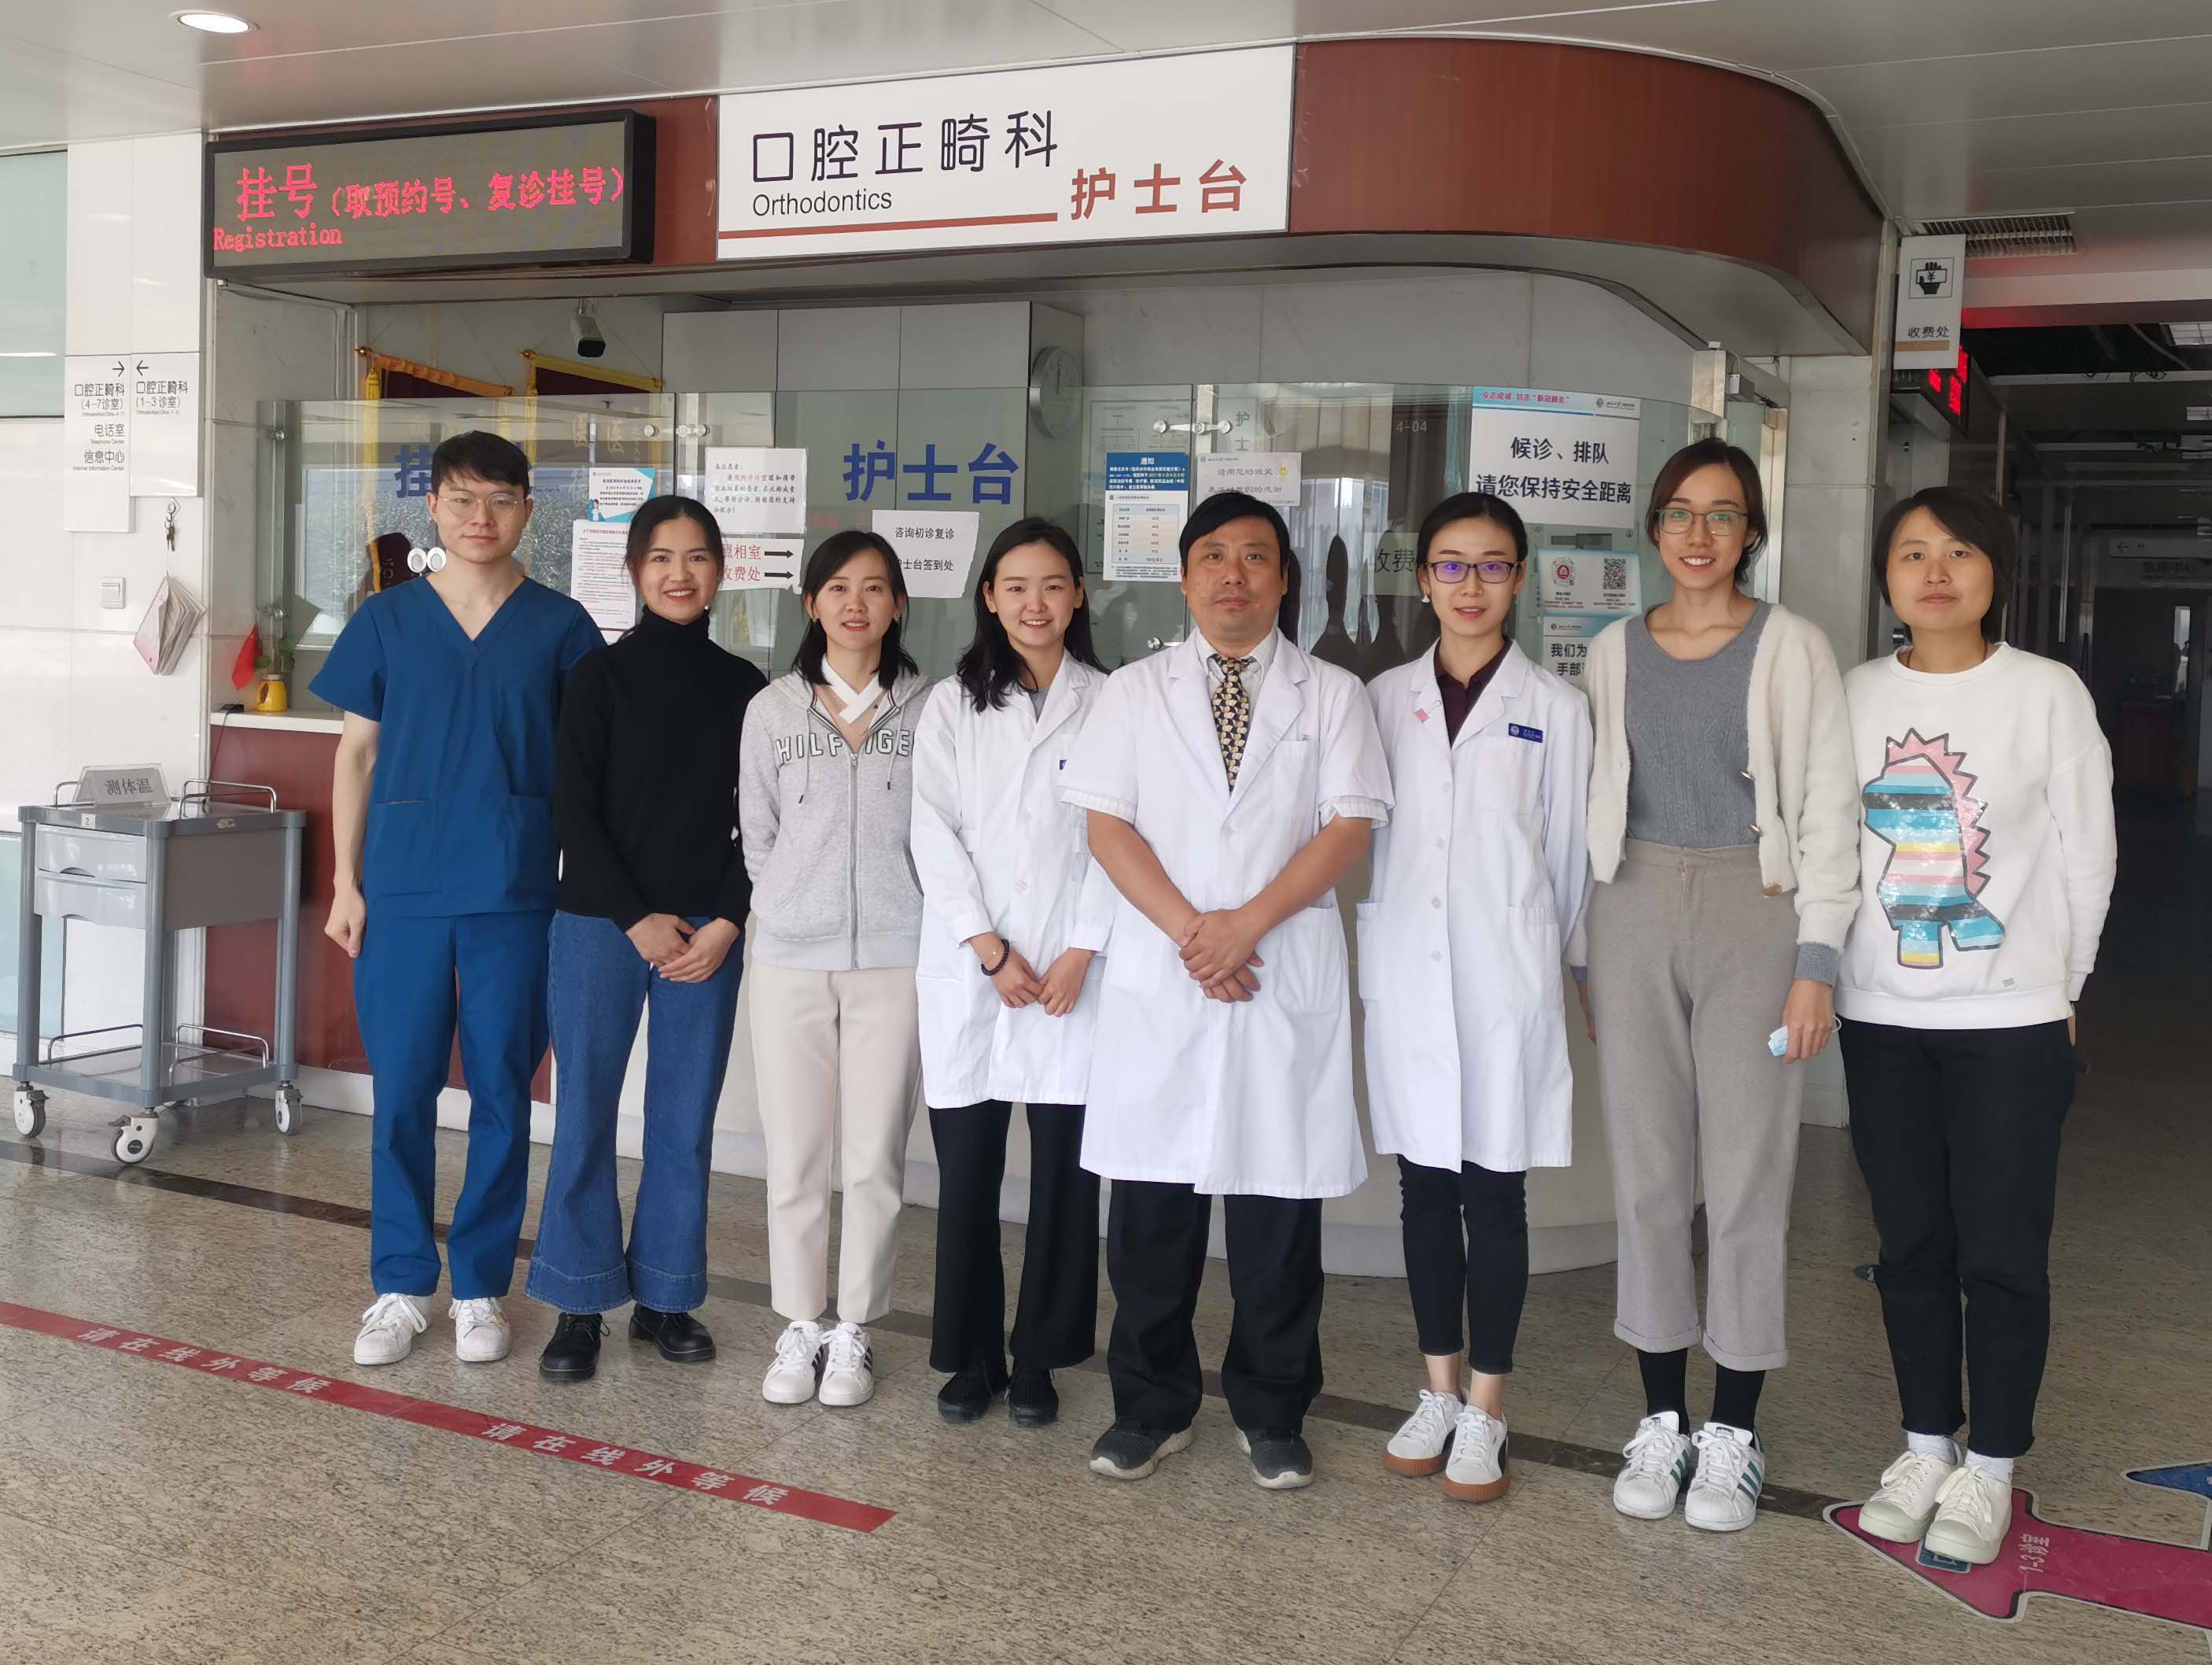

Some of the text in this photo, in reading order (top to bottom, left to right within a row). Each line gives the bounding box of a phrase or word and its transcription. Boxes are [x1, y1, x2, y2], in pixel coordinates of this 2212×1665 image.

[752, 110, 1058, 183] 口腔正畸科
[236, 163, 318, 222] 挂号
[752, 187, 892, 218] Orthodontics
[1071, 159, 1247, 222] 护士台
[213, 222, 343, 252] Registration
[1908, 325, 1950, 338] 收费处
[74, 383, 125, 397] 口腔正畸科
[136, 381, 188, 394] 口腔正畸科
[94, 423, 125, 437] 电话室
[1395, 420, 1429, 433] 4-04
[84, 449, 125, 465] 信息中心
[1510, 437, 1609, 465] 候诊、排队
[842, 440, 1019, 504] 护士台
[1476, 474, 1632, 504] 请您保持安全距离
[894, 526, 955, 540] 咨询初诊复诊
[1373, 548, 1417, 573] 收费
[1550, 643, 1587, 658] 我们为
[1556, 662, 1586, 677] 手部
[775, 728, 915, 766] HILFIGE
[105, 778, 153, 795] 测体温
[76, 1327, 334, 1394] 请在线外等候
[473, 1423, 791, 1506] 请在线外等候
